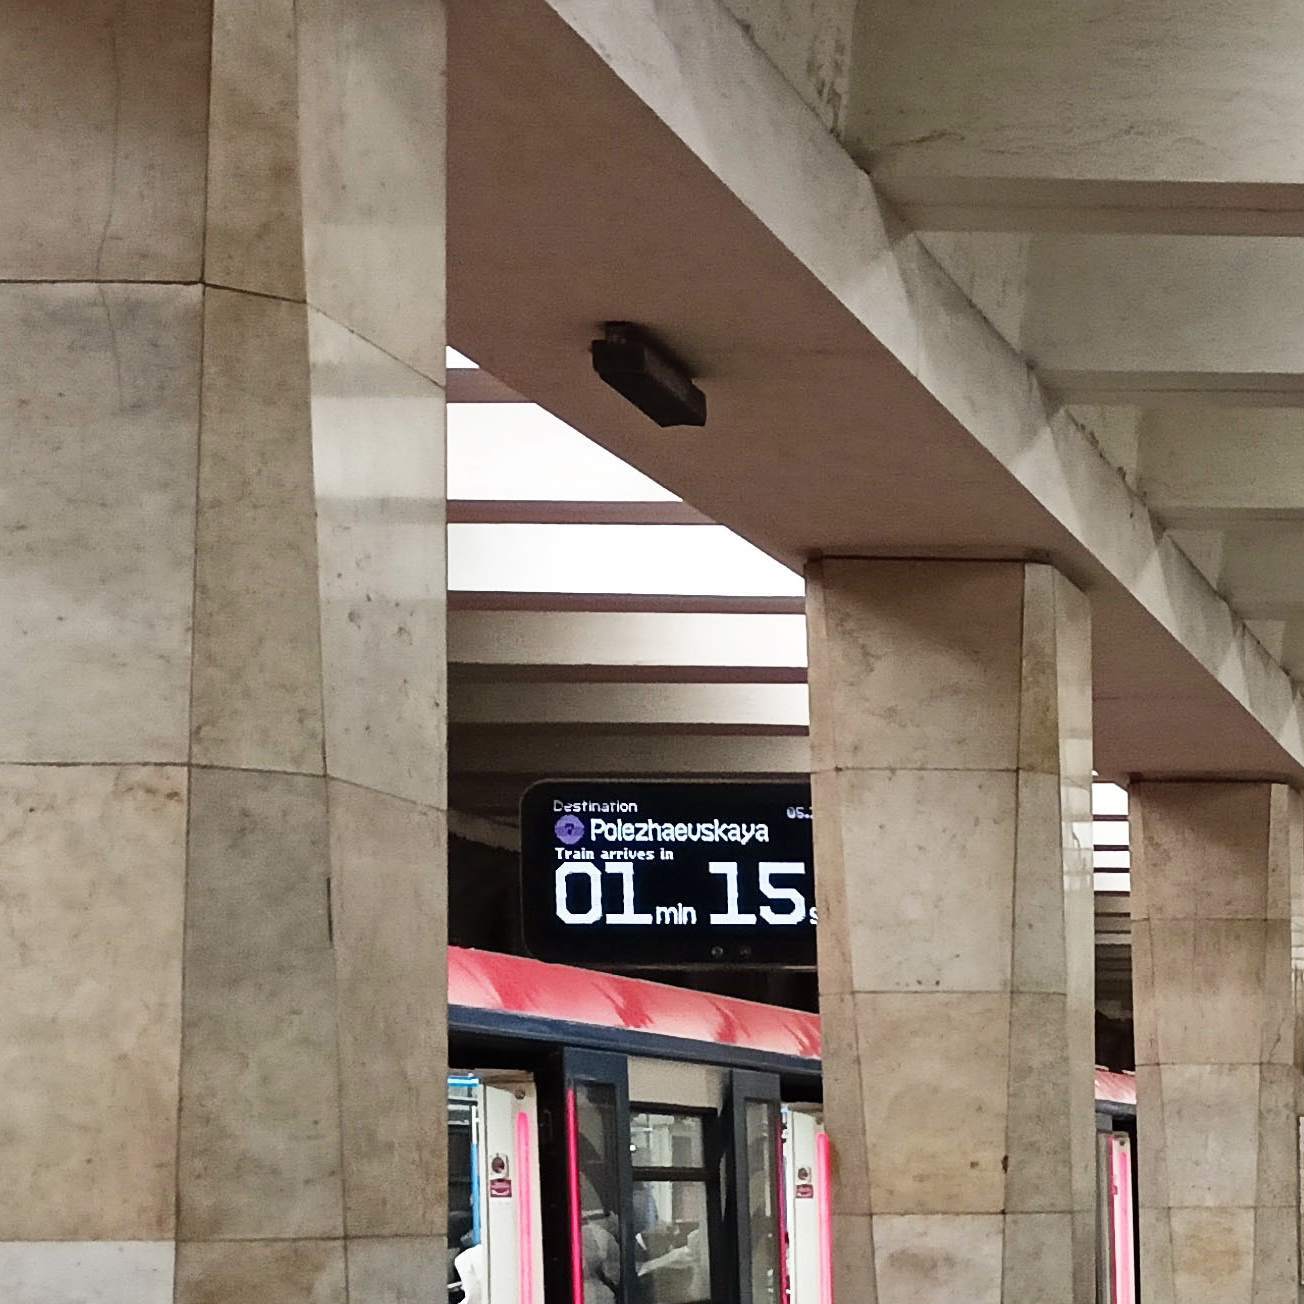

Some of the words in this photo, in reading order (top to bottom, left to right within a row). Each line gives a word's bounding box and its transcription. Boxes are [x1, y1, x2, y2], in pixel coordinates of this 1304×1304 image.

[553, 799, 638, 814] Destination
[590, 818, 769, 845] Polezhaevskaya
[555, 847, 595, 861] Train
[600, 847, 655, 861] arrives
[659, 847, 674, 861] in
[555, 861, 653, 925] 01
[655, 902, 697, 925] min
[708, 861, 806, 925] 15
